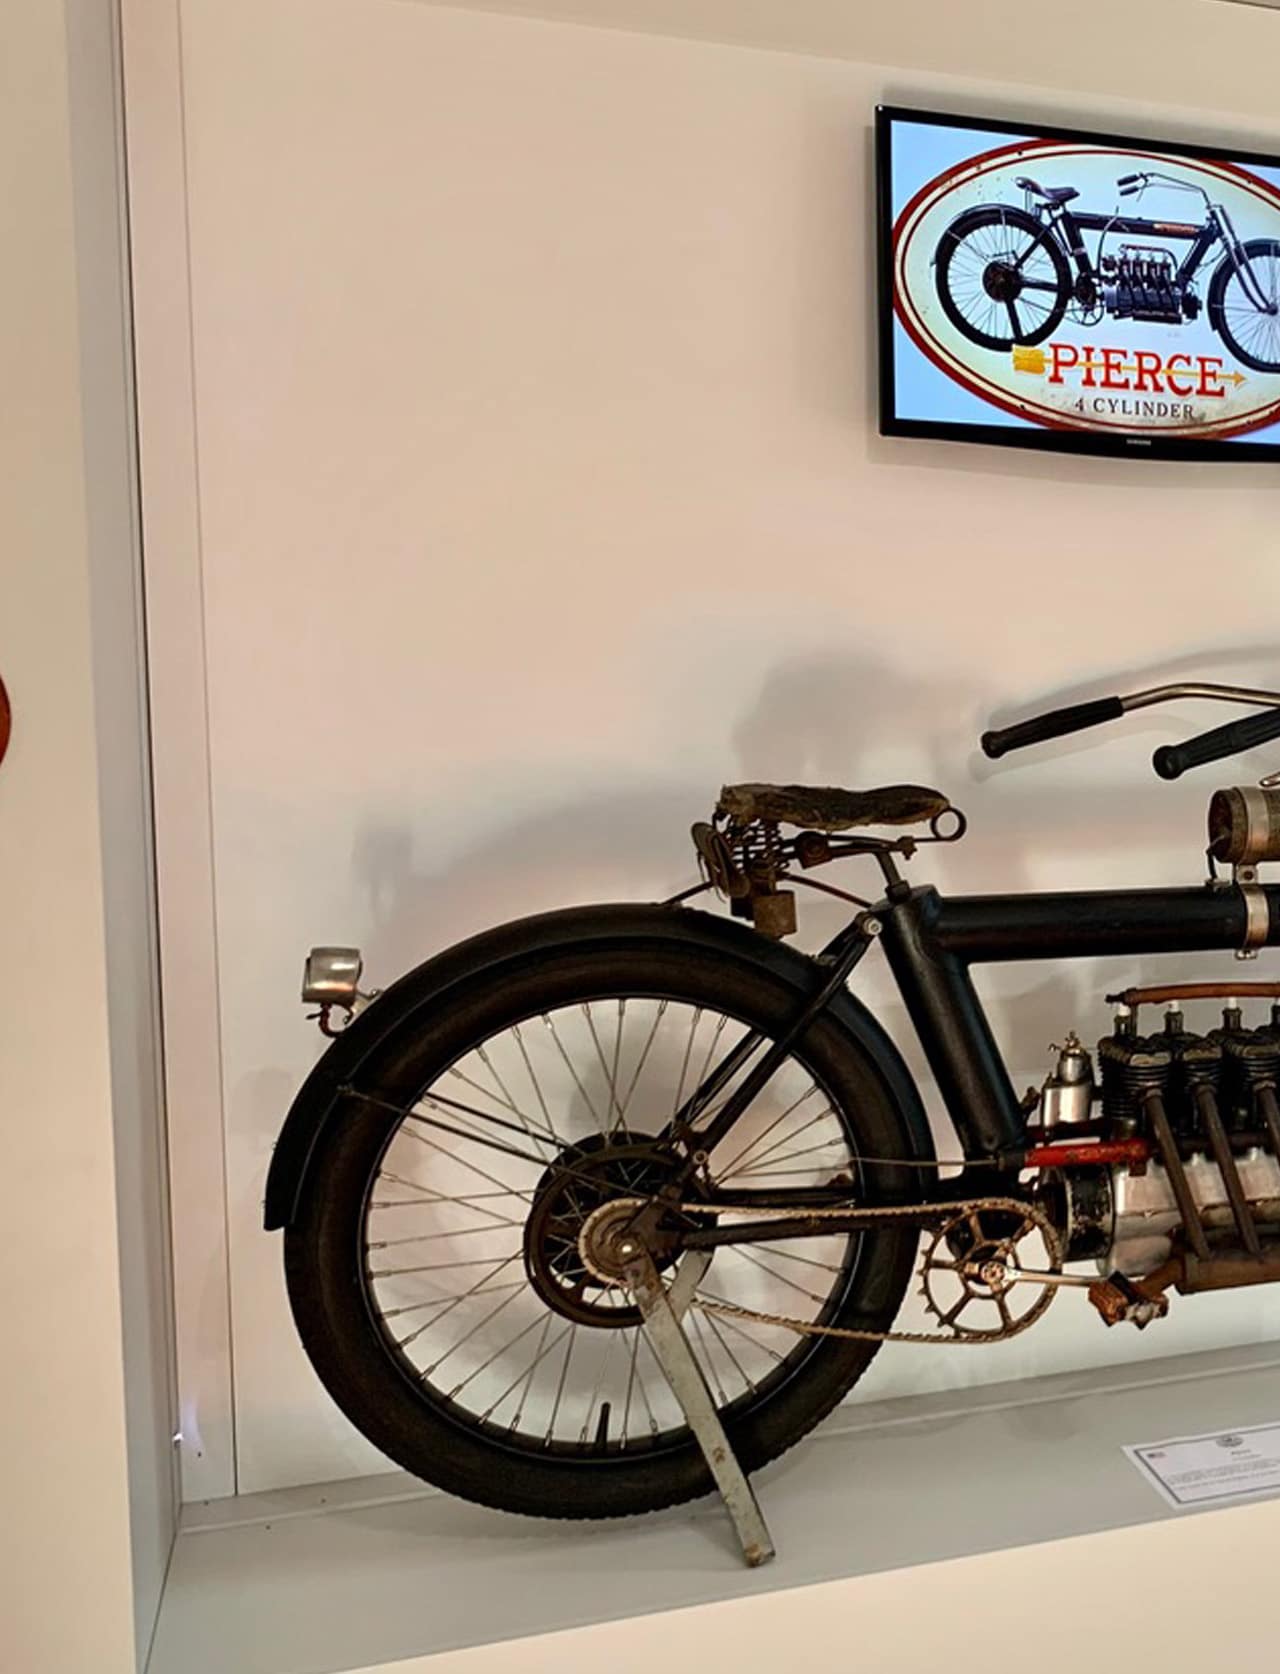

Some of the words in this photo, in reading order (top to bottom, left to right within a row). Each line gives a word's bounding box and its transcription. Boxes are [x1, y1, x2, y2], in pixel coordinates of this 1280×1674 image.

[1048, 343, 1226, 397] PIERCE
[1074, 397, 1084, 412] 4
[1093, 398, 1194, 418] CYLINDER
